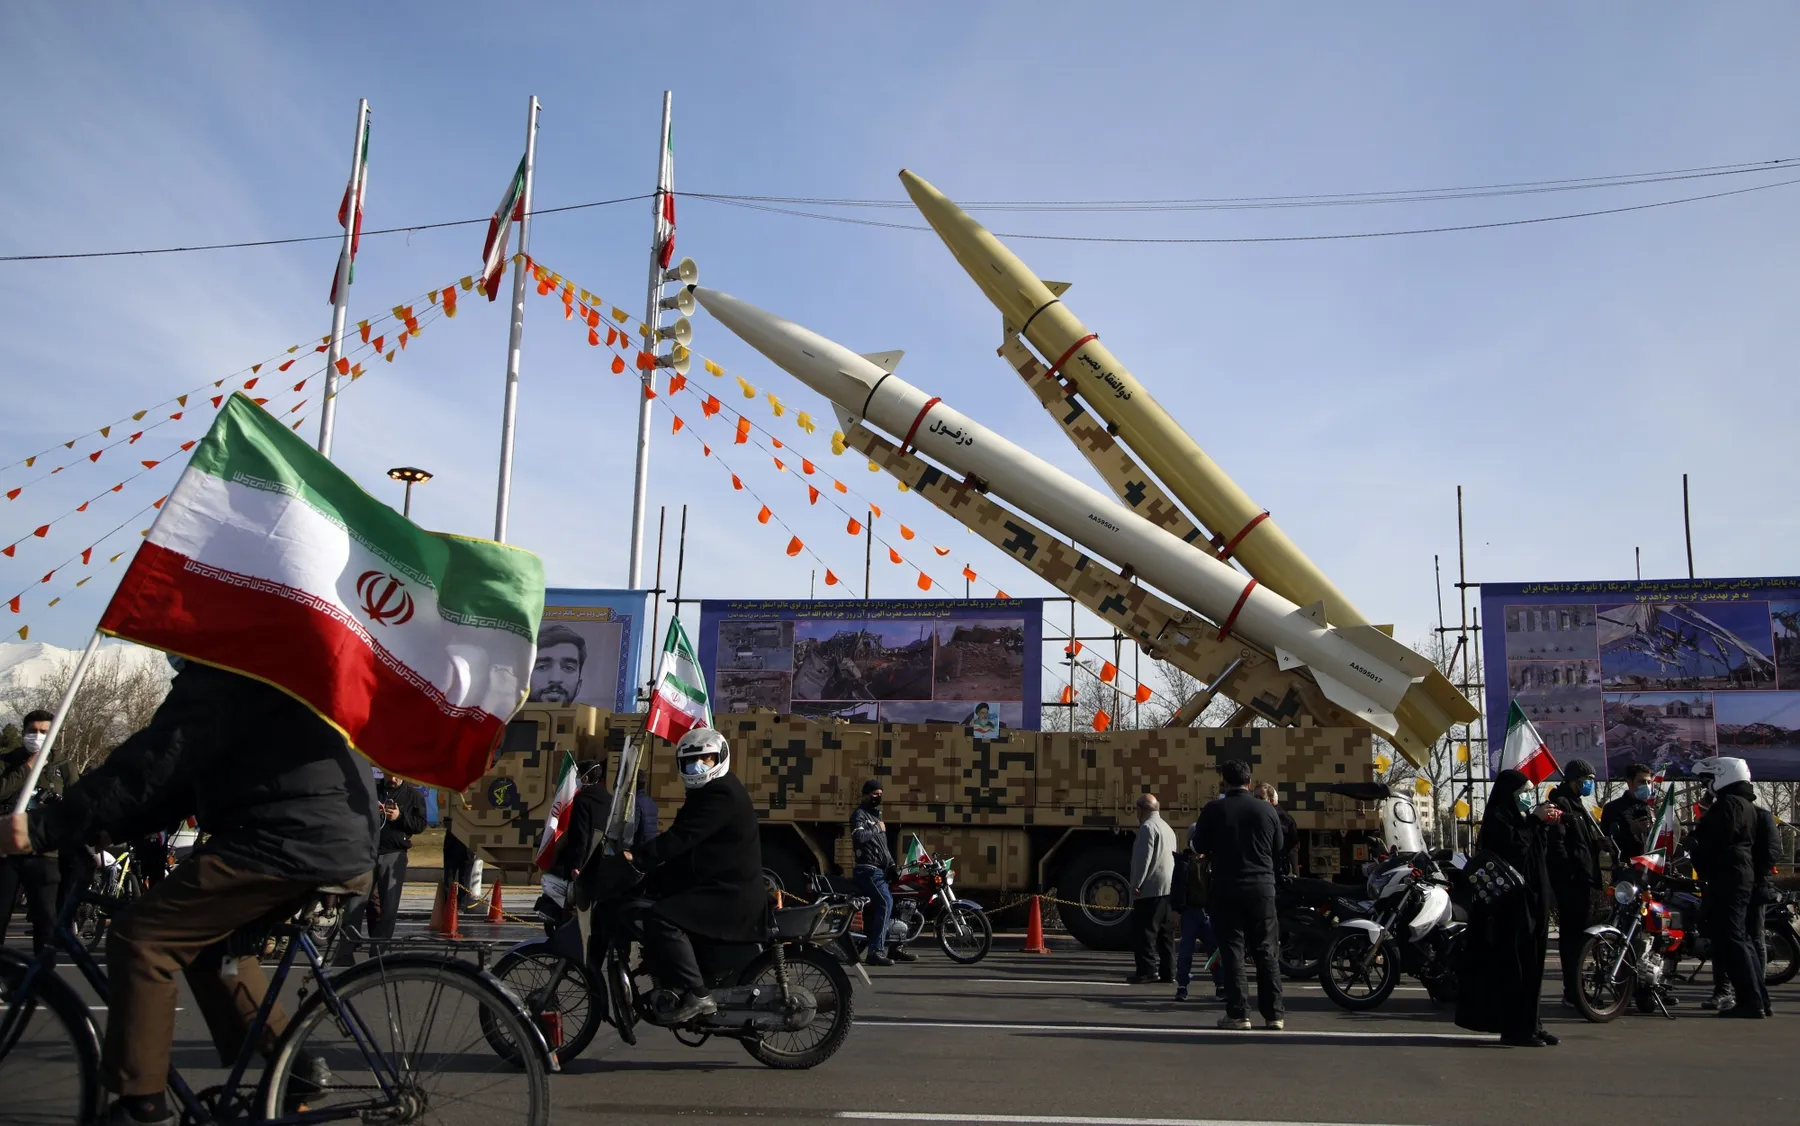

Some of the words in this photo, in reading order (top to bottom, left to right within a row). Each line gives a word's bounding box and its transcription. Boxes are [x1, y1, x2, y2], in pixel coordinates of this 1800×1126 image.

[1095, 372, 1133, 400] ذوالفقار
[929, 420, 973, 446] دزفول
[1088, 513, 1120, 534] AA595017
[1522, 584, 1541, 594] ایران
[1635, 594, 1647, 602] بود
[1648, 593, 1672, 602] خواهد
[1700, 592, 1728, 601] تهدیدی
[1730, 592, 1740, 601] هر
[1349, 662, 1383, 684] AA595017
